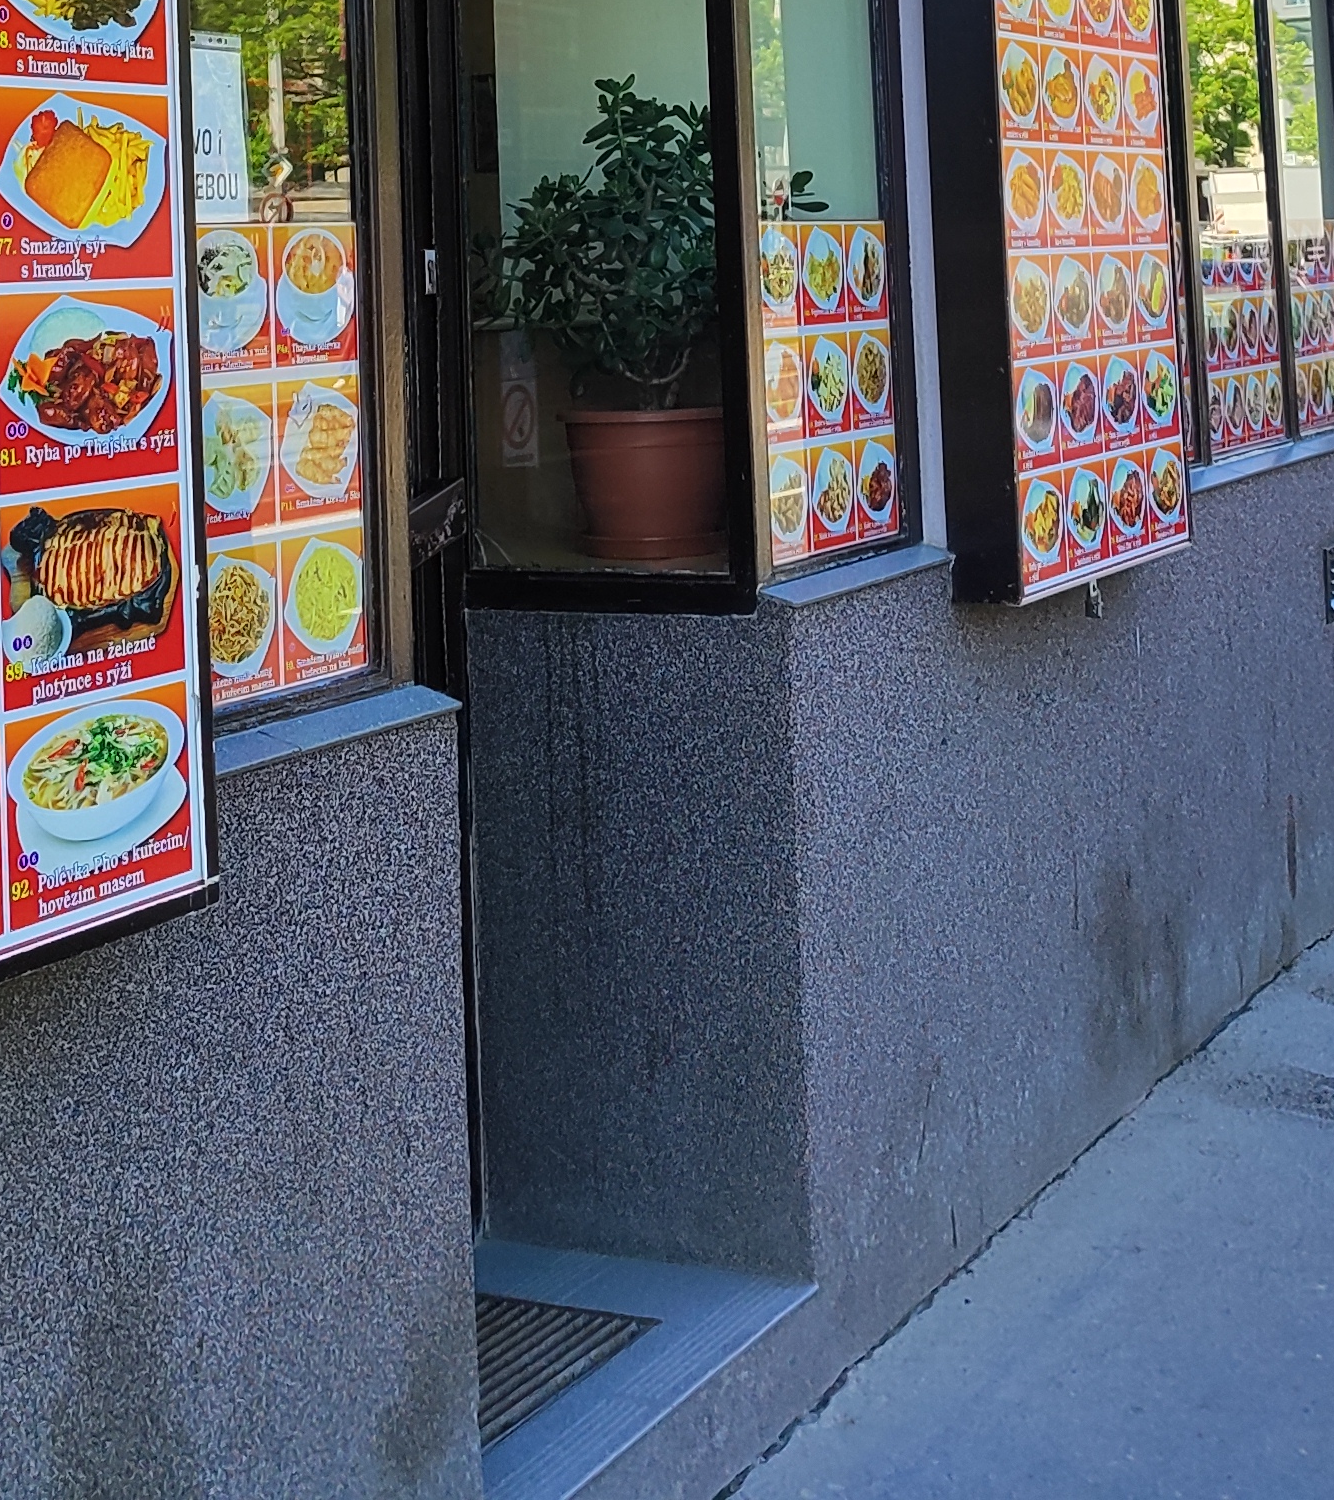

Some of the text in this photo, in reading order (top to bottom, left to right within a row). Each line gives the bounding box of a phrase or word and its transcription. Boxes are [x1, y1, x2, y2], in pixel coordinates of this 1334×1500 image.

[16, 32, 77, 54] Smažená
[124, 41, 154, 62] játra
[17, 55, 88, 80] s hranolky
[21, 235, 81, 259] Smažený
[86, 235, 106, 258] sýr
[21, 259, 93, 281] s hranolky
[0, 429, 175, 467] 81. Ryba po Thajsku s rýží
[6, 632, 156, 682] 89. Kachna na železné
[33, 661, 132, 705] plotýnce s rýží
[12, 879, 34, 901] 92.
[38, 861, 90, 894] Polévka
[93, 851, 118, 875] Pho
[121, 851, 128, 865] s
[39, 868, 144, 917] hovězím masem
